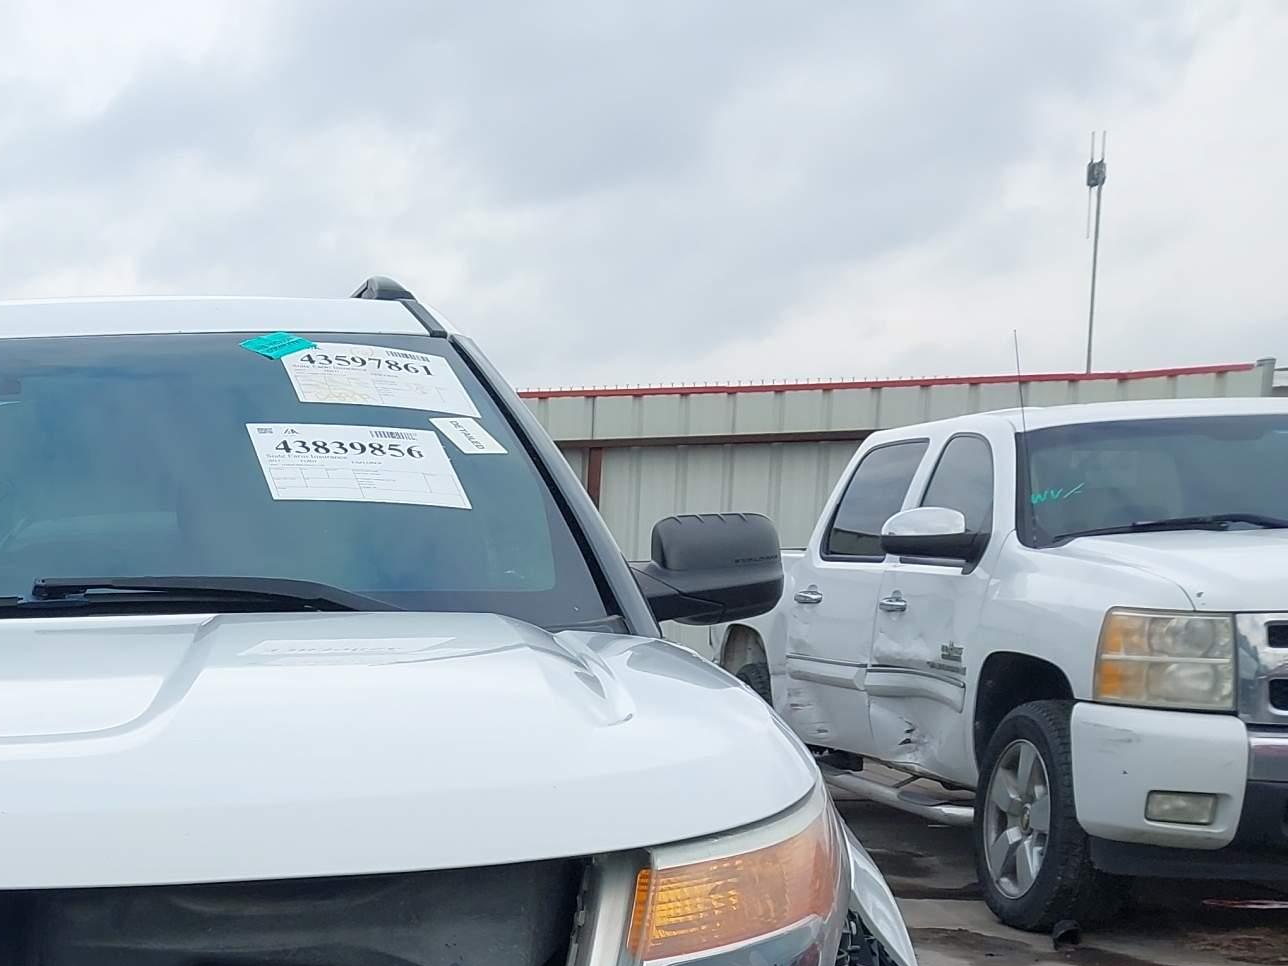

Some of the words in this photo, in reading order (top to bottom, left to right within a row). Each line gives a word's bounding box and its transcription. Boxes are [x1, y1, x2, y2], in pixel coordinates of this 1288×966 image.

[299, 353, 434, 376] 43597861
[449, 420, 485, 450] DETAILED
[274, 439, 425, 459] 43839856
